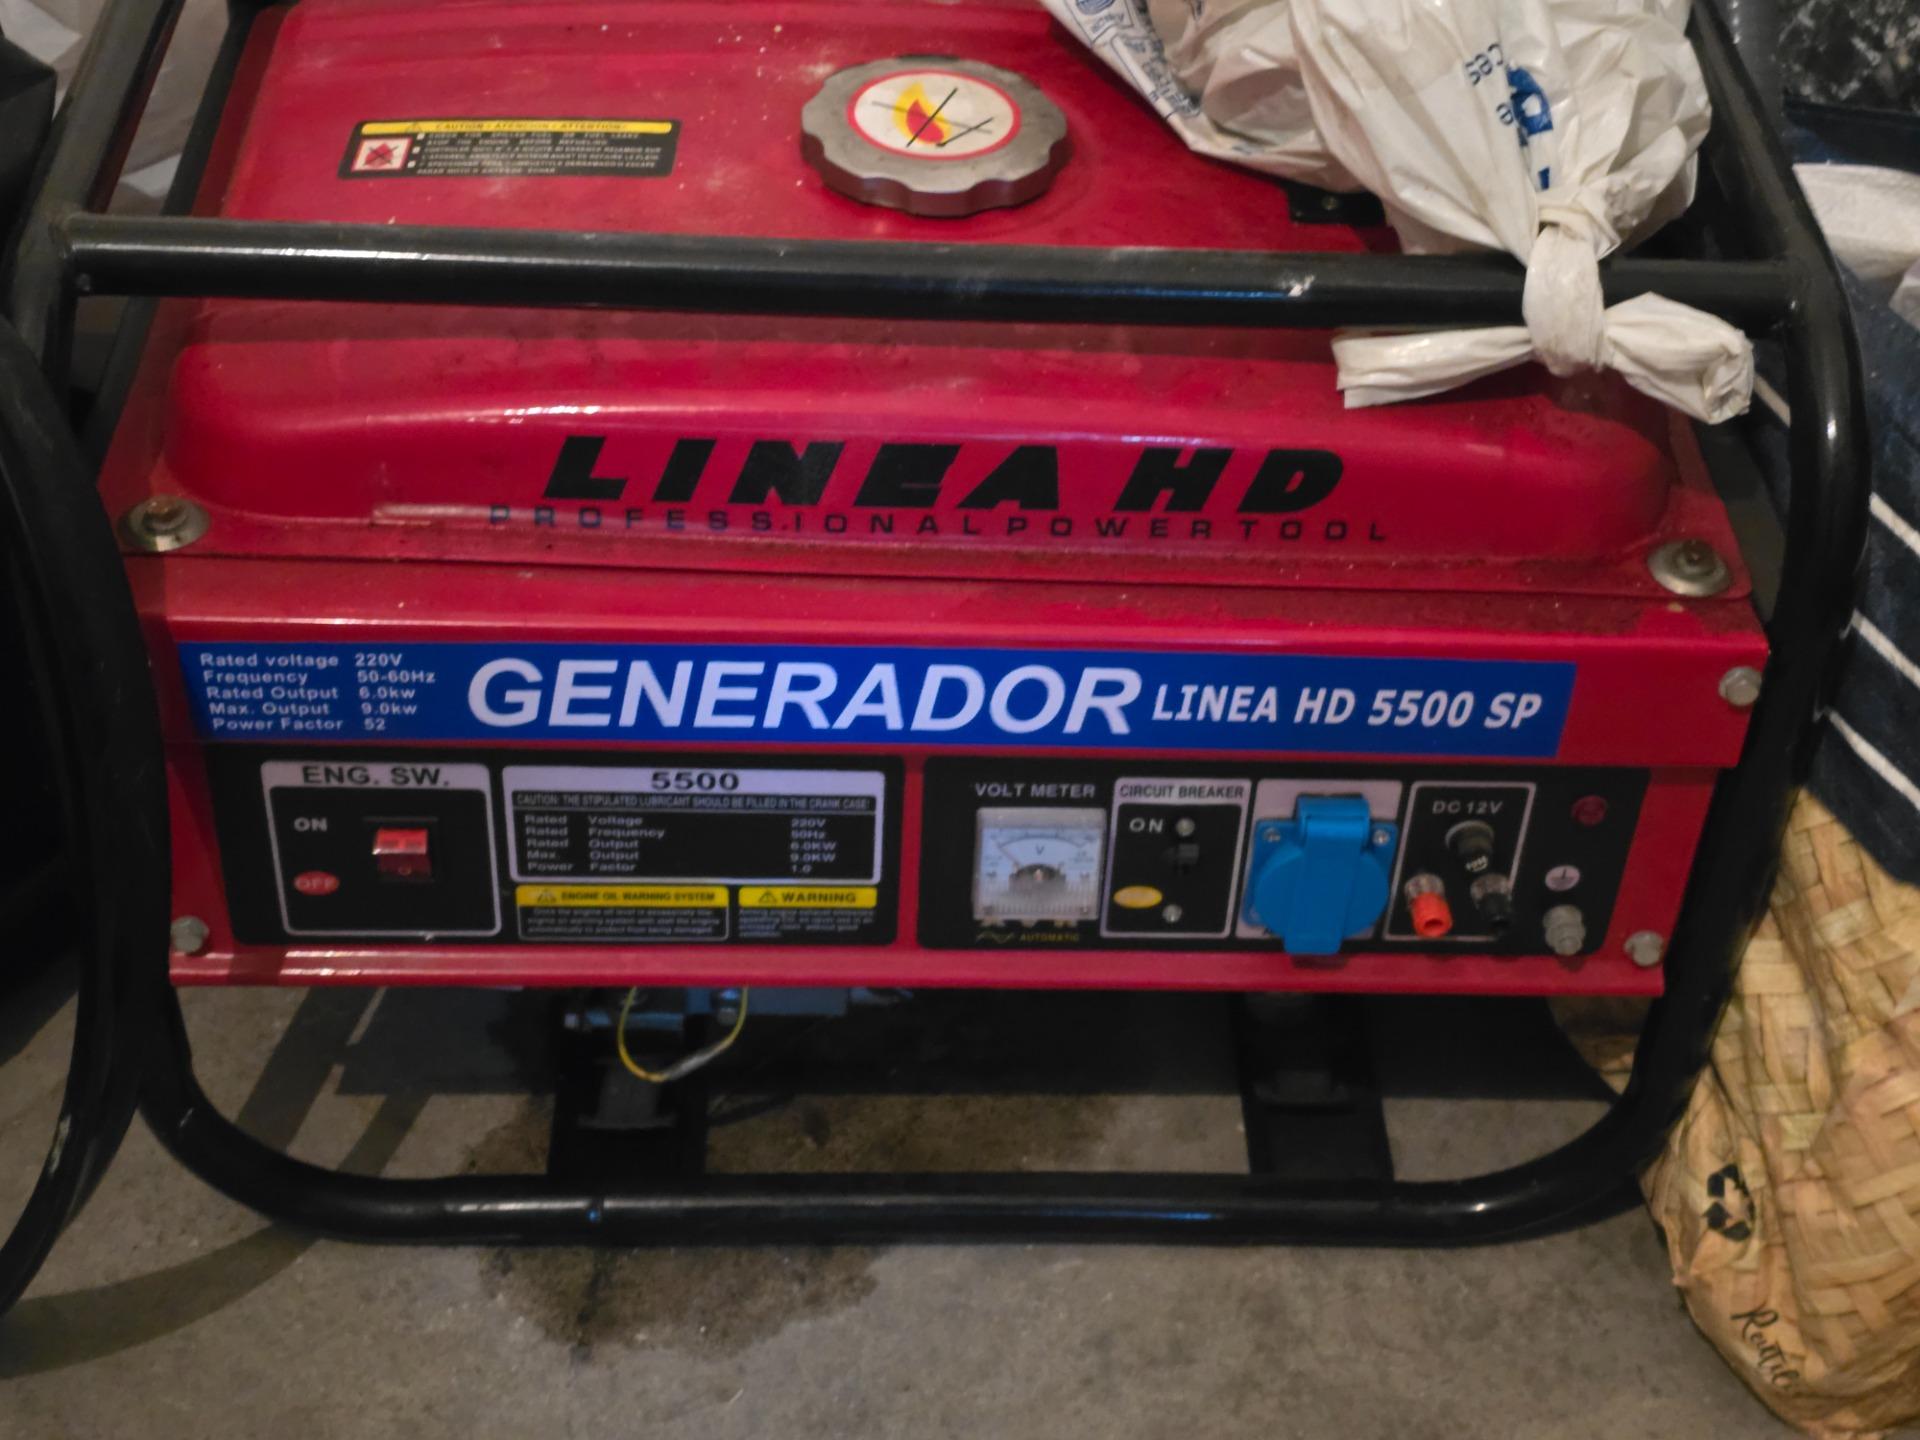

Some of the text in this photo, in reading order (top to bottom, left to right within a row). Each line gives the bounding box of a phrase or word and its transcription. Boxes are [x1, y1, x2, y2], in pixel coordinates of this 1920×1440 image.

[543, 436, 1344, 514] LINEA HD
[200, 653, 402, 670] Rated voltage 220V
[203, 670, 436, 685] Frequency 50-60Hz
[206, 687, 416, 701] Rated Output 6.0kw
[467, 658, 1542, 735] GENERADOR LINEA HD 5500 SP
[209, 702, 418, 717] Max. Output 9.0kw
[213, 718, 386, 731] Power Factor 52
[302, 766, 450, 787] ENG. SW.
[651, 772, 739, 791] 5500
[975, 783, 1096, 798] VOLT METER
[1119, 785, 1245, 799] CIRCUIT BREAKER
[1432, 801, 1503, 814] DC 12V
[294, 817, 328, 832] ON
[524, 814, 826, 828] Rated Voltage 220V
[1129, 818, 1164, 833] ON
[525, 826, 568, 836] Rated
[588, 828, 665, 840] Frequency
[526, 838, 569, 848] Rated
[588, 840, 639, 850] Output
[589, 851, 640, 861] Output
[527, 862, 574, 872] Power
[589, 862, 637, 872] Factor
[781, 892, 857, 903] WARNING
